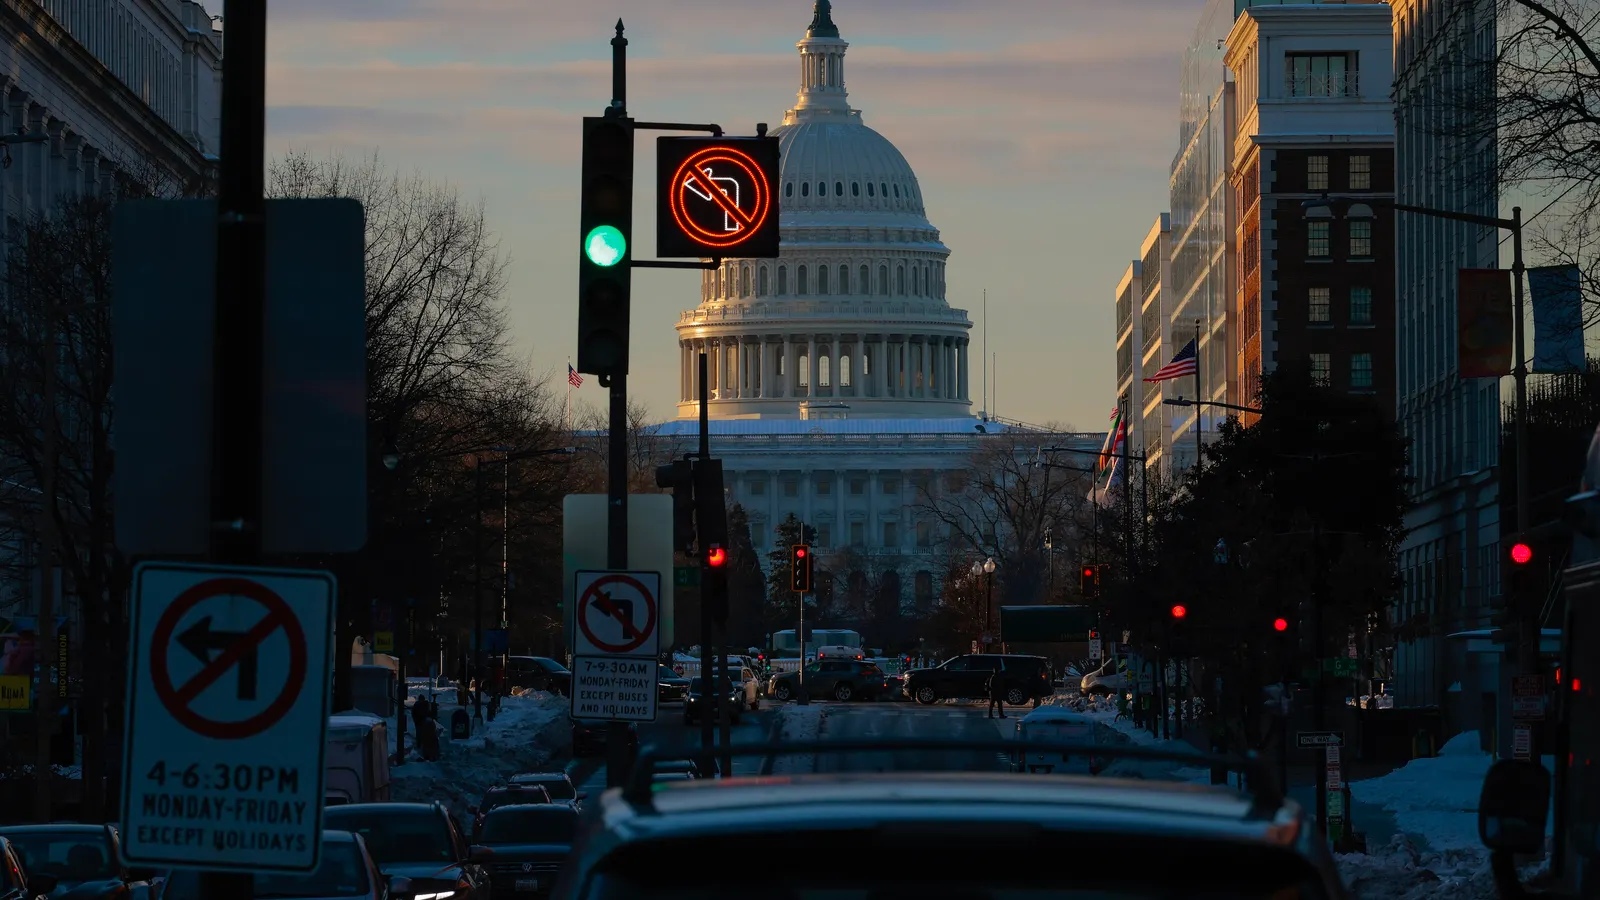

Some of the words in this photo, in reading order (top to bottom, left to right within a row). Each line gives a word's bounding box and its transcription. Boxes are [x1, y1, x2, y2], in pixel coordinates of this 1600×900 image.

[59, 634, 68, 697] NOMABID.ORG
[585, 661, 647, 674] 7-9:30AM
[580, 676, 649, 688] MONDAY-FRIDAY
[580, 690, 614, 701] EXCEPT
[618, 692, 648, 702] BUSES
[580, 703, 599, 713] AND
[602, 704, 648, 715] HOLIDAYS
[146, 759, 299, 794] 4-6:30PM
[142, 793, 306, 825] MONDAY-FRIDAY
[137, 825, 205, 846] EXCEPT
[213, 828, 307, 852] HOLIDAYS
